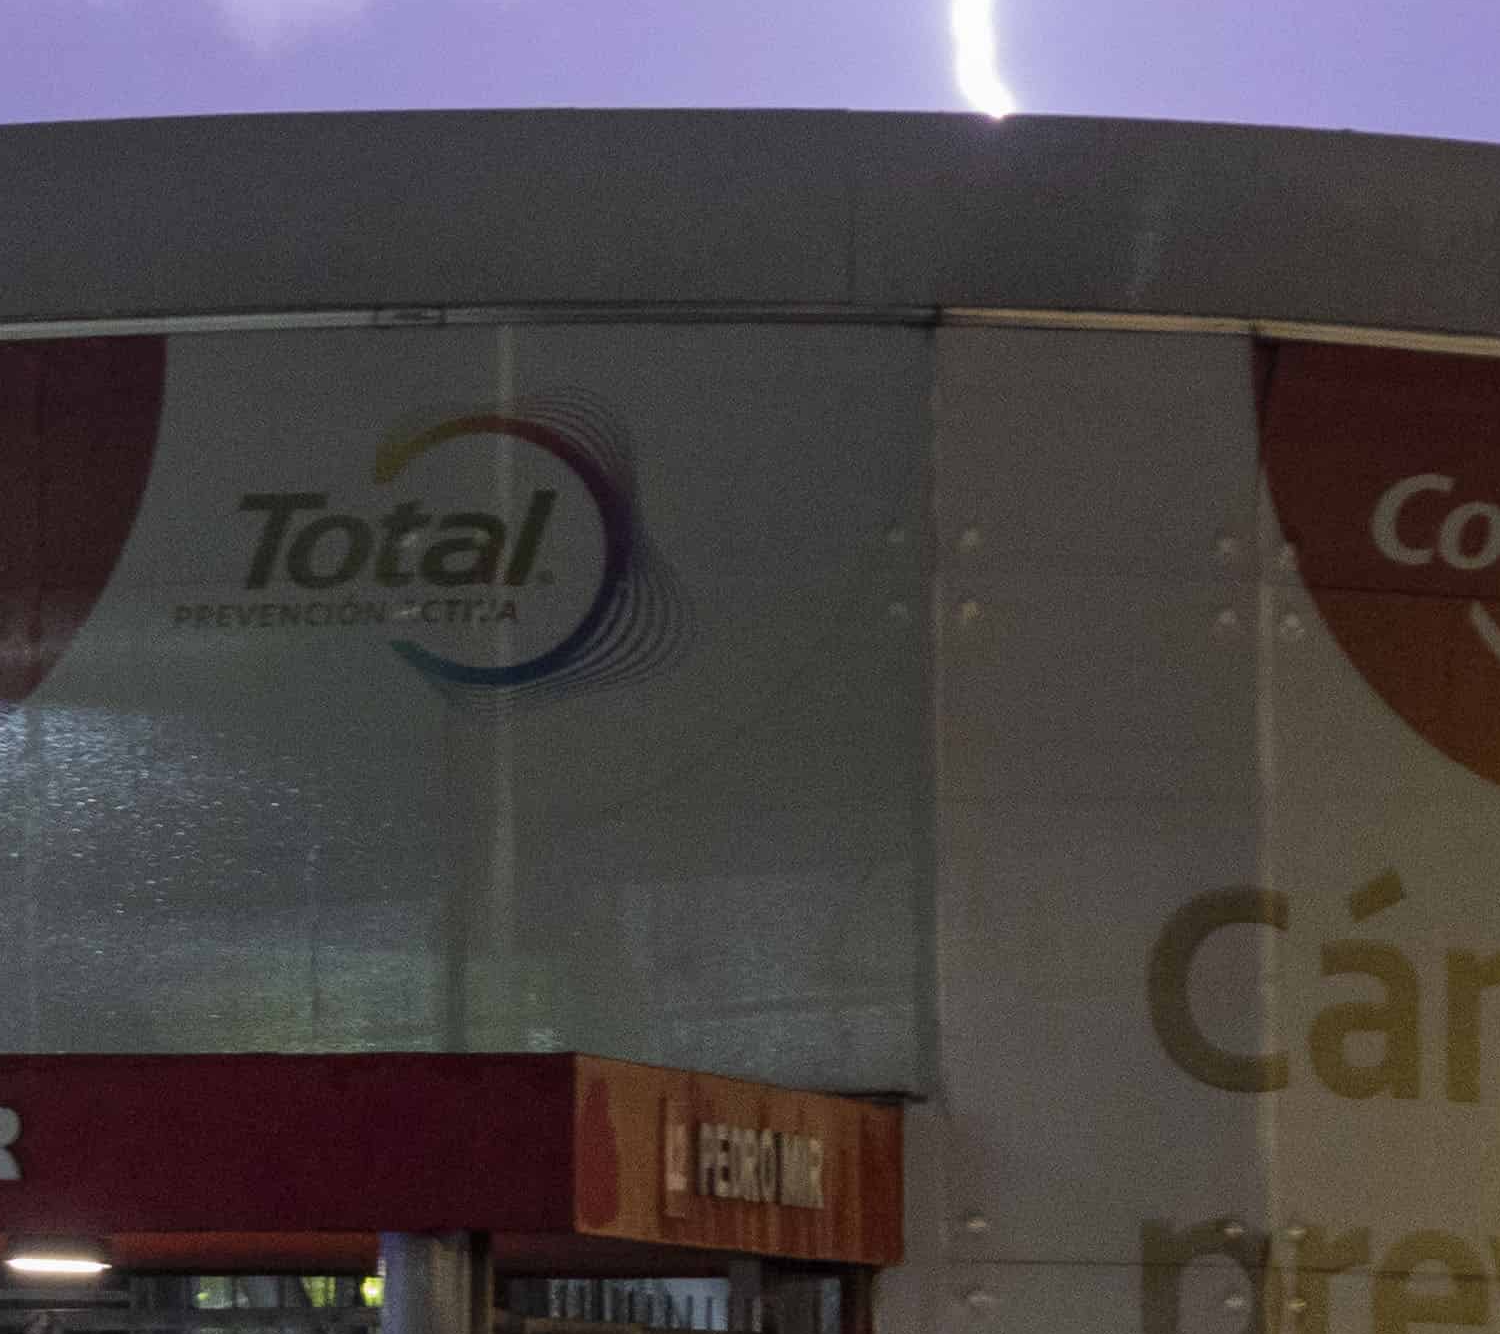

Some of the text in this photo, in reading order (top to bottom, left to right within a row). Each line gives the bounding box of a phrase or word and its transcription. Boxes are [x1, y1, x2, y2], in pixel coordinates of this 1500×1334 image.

[236, 487, 560, 591] Total
[173, 593, 520, 628] PREVENCIÓN CTIA
